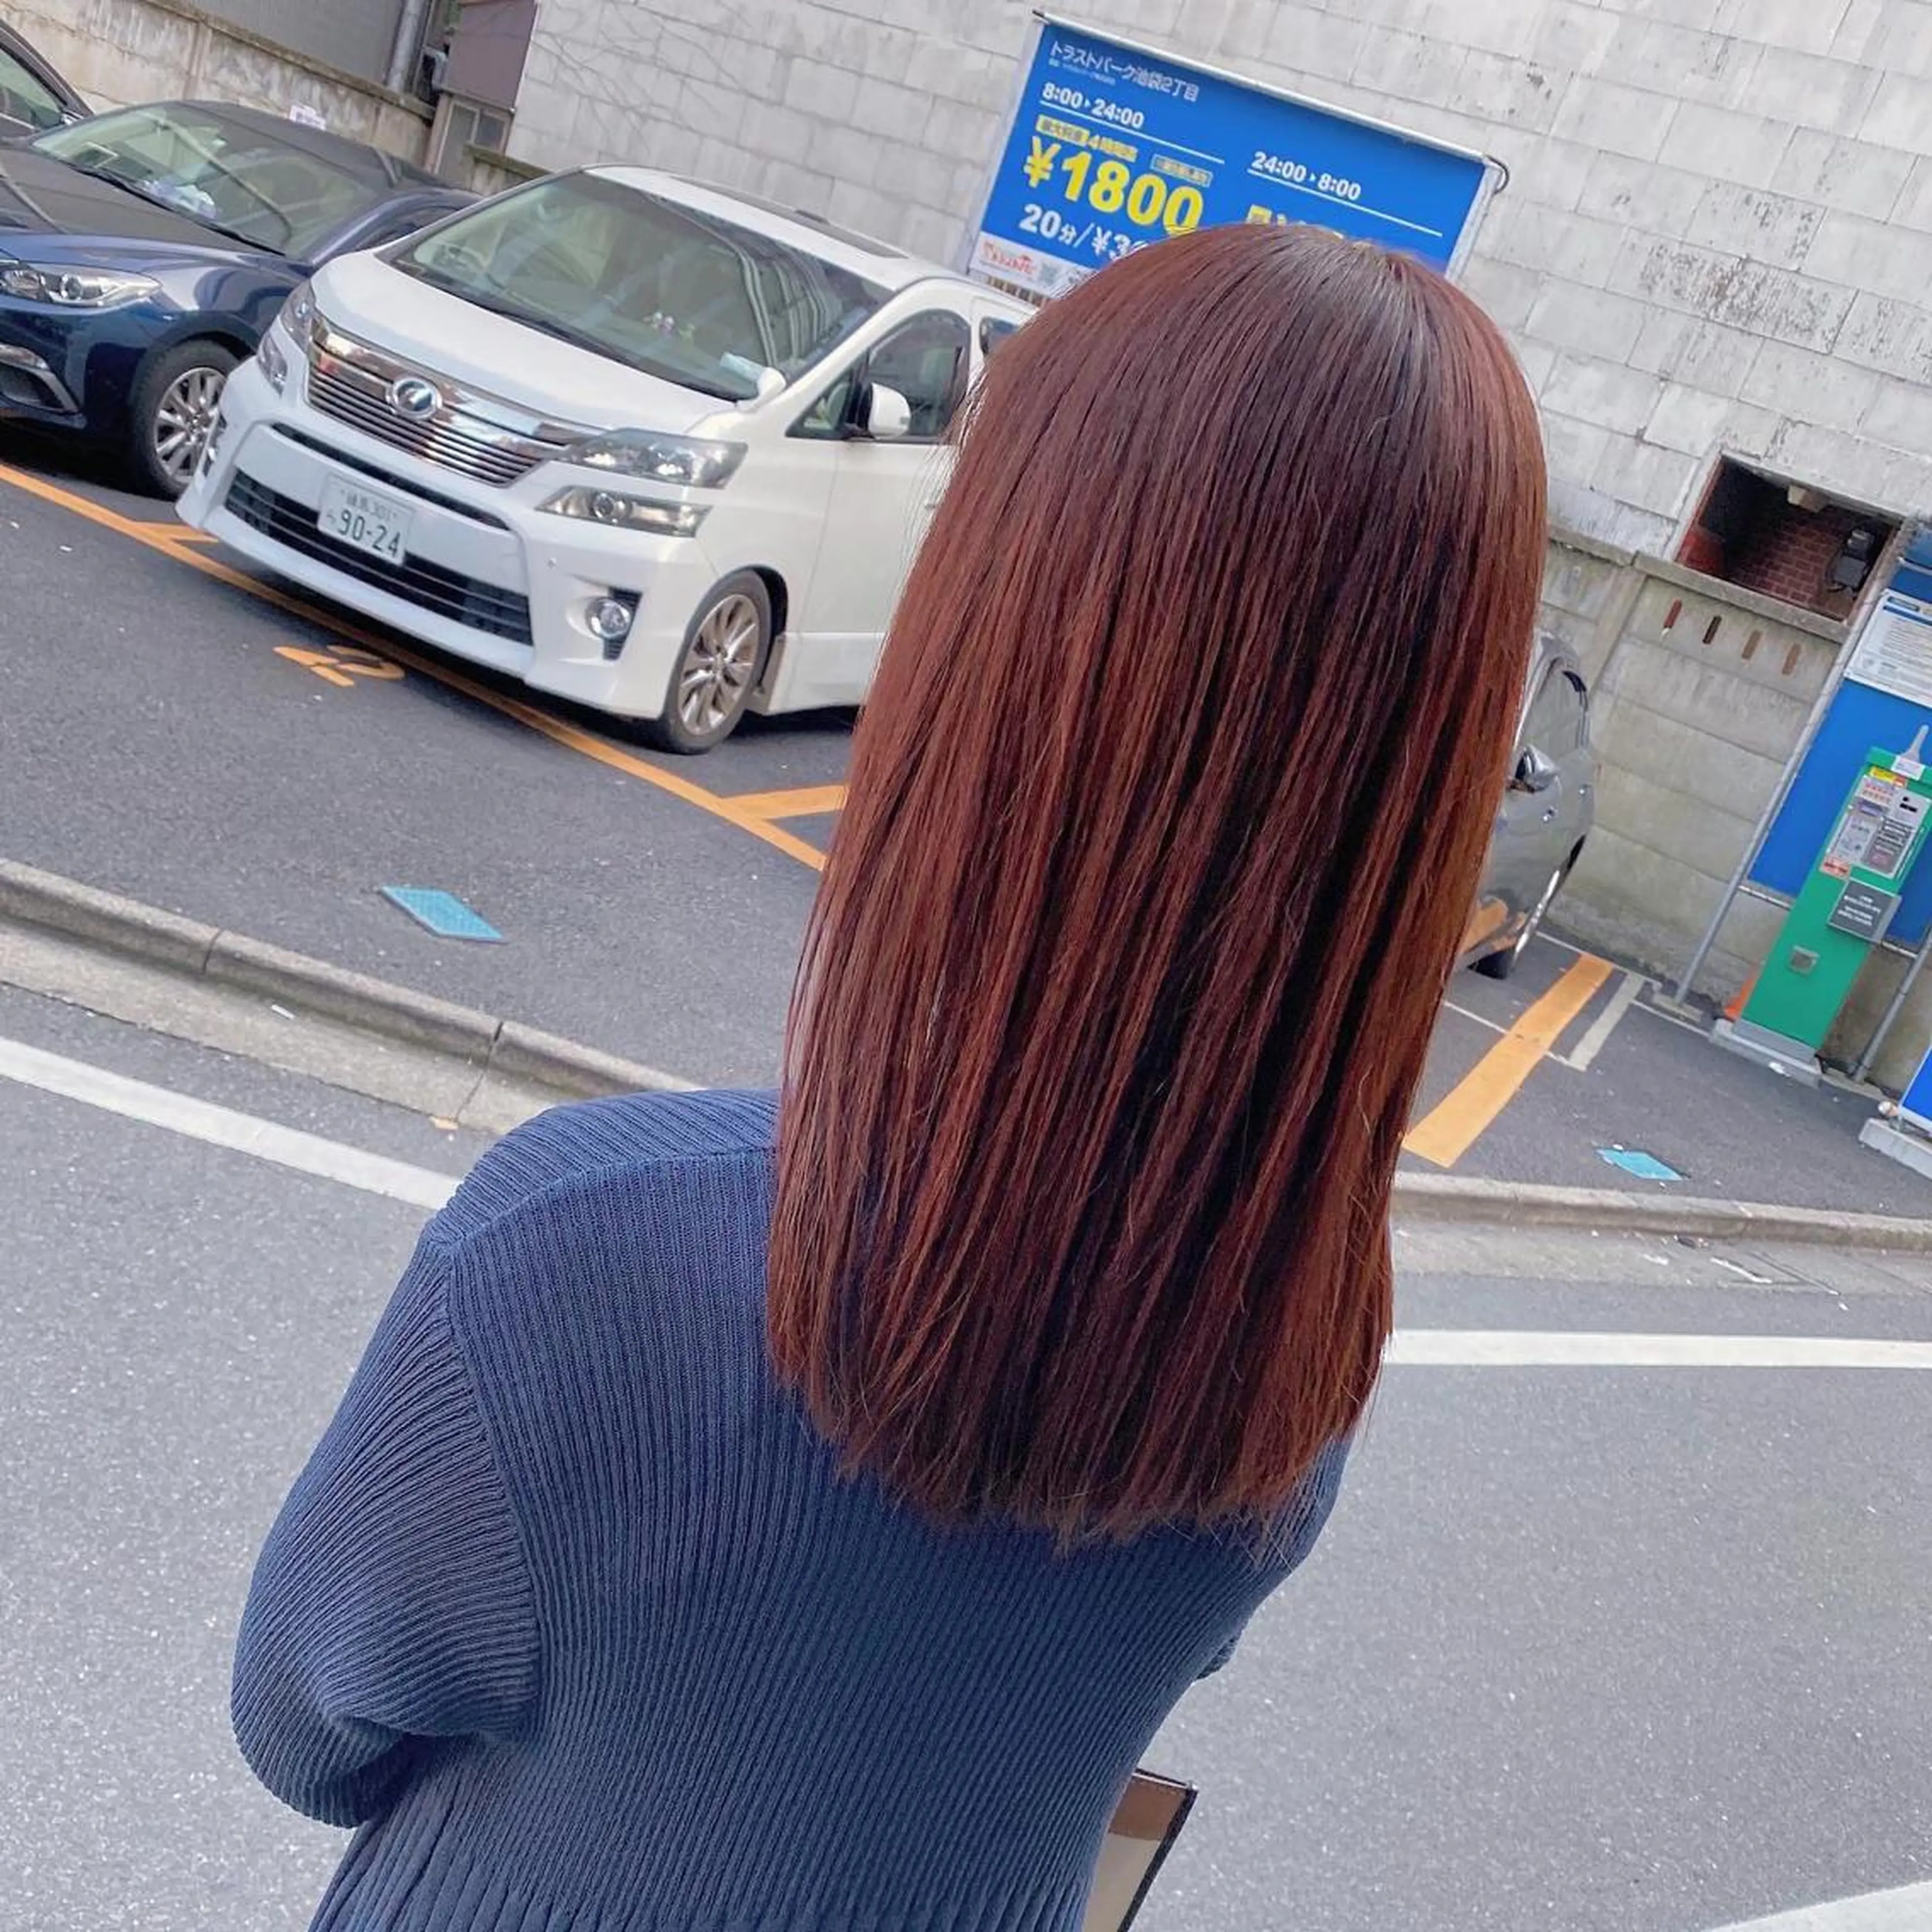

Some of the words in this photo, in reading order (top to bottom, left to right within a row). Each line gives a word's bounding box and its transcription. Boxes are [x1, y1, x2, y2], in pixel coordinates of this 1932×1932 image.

[1042, 82, 1083, 109] 8:00
[1091, 98, 1145, 129] 24:00
[1024, 135, 1203, 238] ¥1800
[1251, 151, 1307, 182] 24:00
[1317, 173, 1361, 201] 8:00
[338, 509, 400, 558] 90-24
